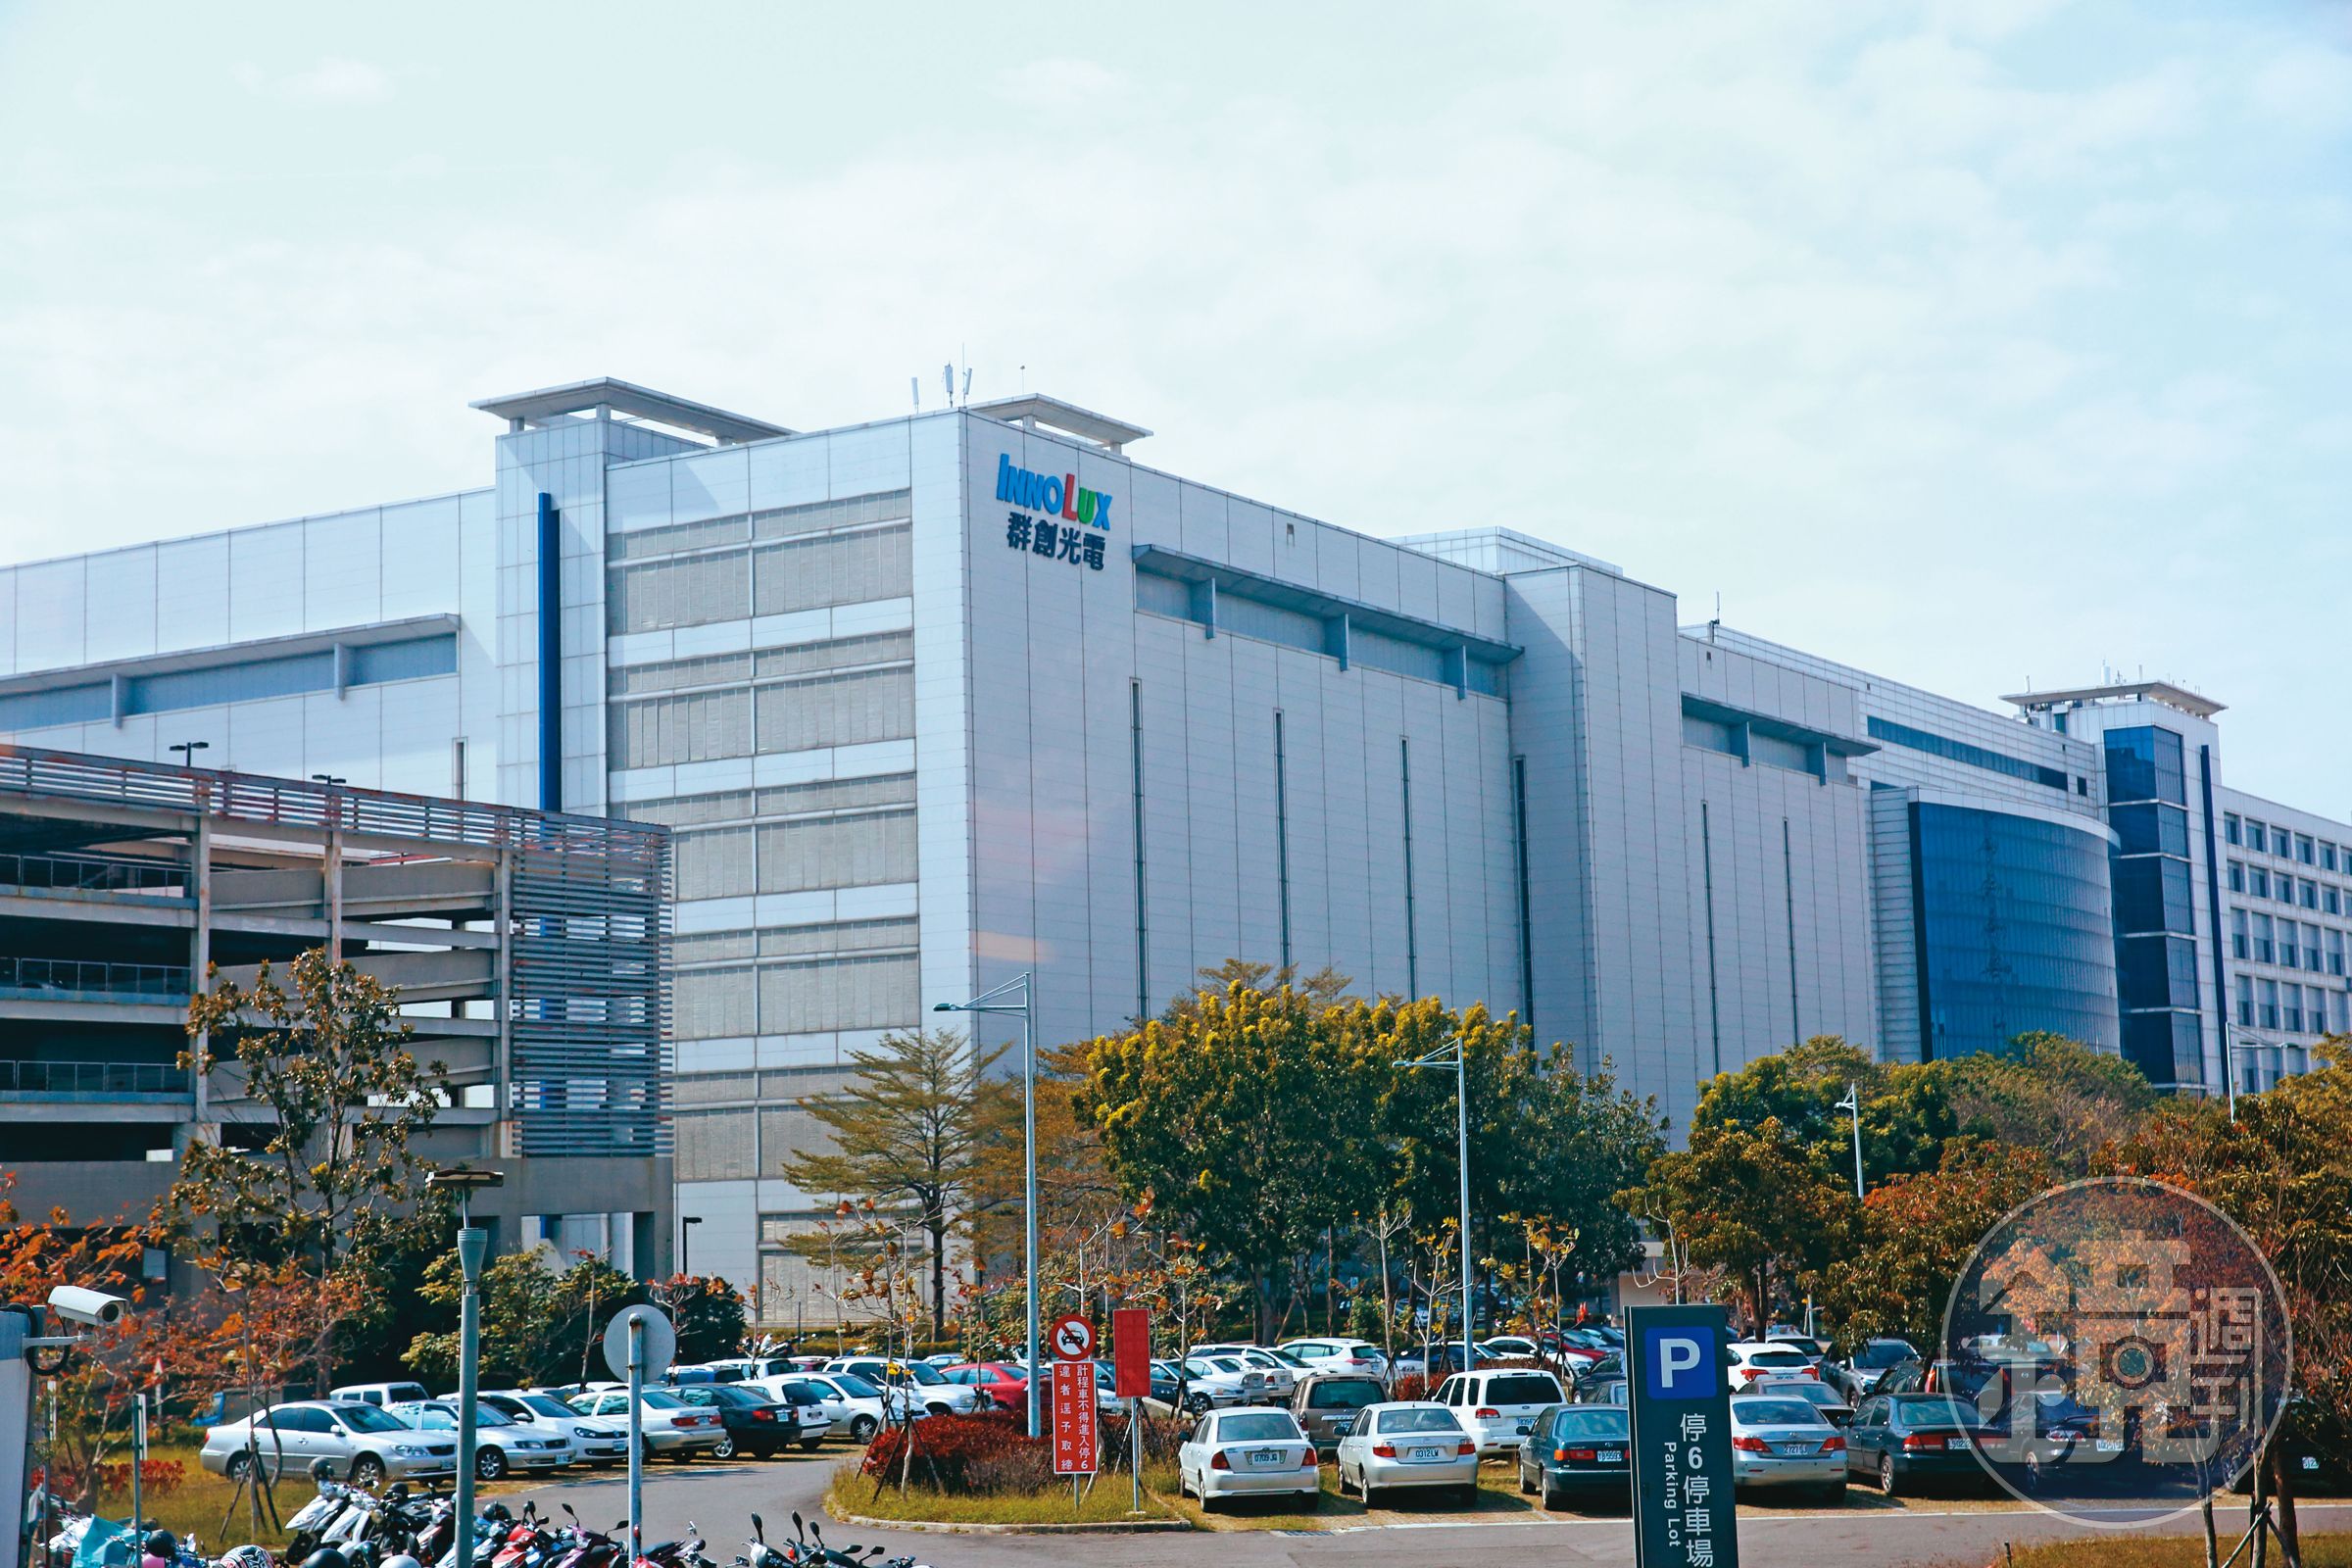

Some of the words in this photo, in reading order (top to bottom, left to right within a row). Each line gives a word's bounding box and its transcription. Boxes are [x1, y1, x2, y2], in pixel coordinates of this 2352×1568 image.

[1006, 511, 1105, 571] 群創光電
[1659, 1338, 1700, 1388] P
[1663, 1442, 1679, 1509] Parking
[1679, 1412, 1714, 1567] 停6停車場
[1668, 1518, 1681, 1547] Lot
